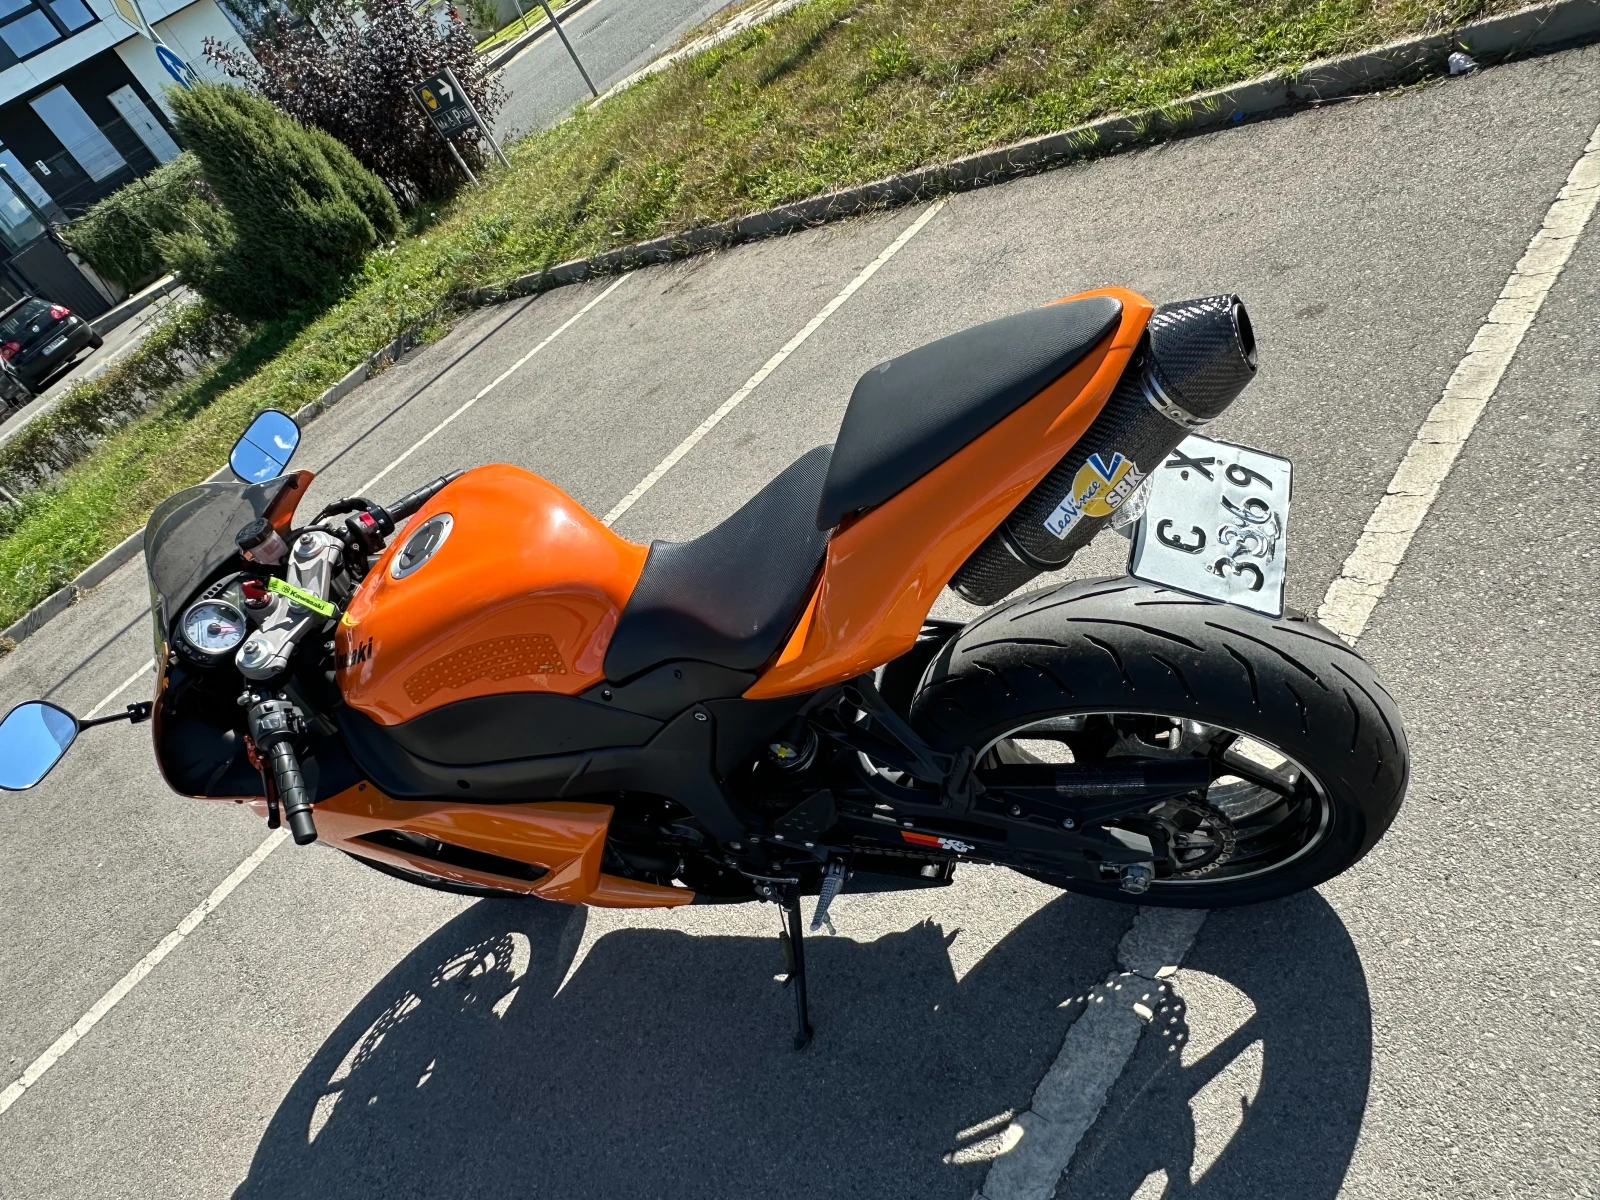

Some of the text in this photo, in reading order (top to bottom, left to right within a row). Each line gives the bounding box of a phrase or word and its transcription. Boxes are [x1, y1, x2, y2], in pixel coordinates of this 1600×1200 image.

[1047, 481, 1101, 536] LeoVince
[1105, 464, 1143, 508] SBK
[1213, 463, 1273, 592] 3369
[289, 589, 326, 611] Kawasaki
